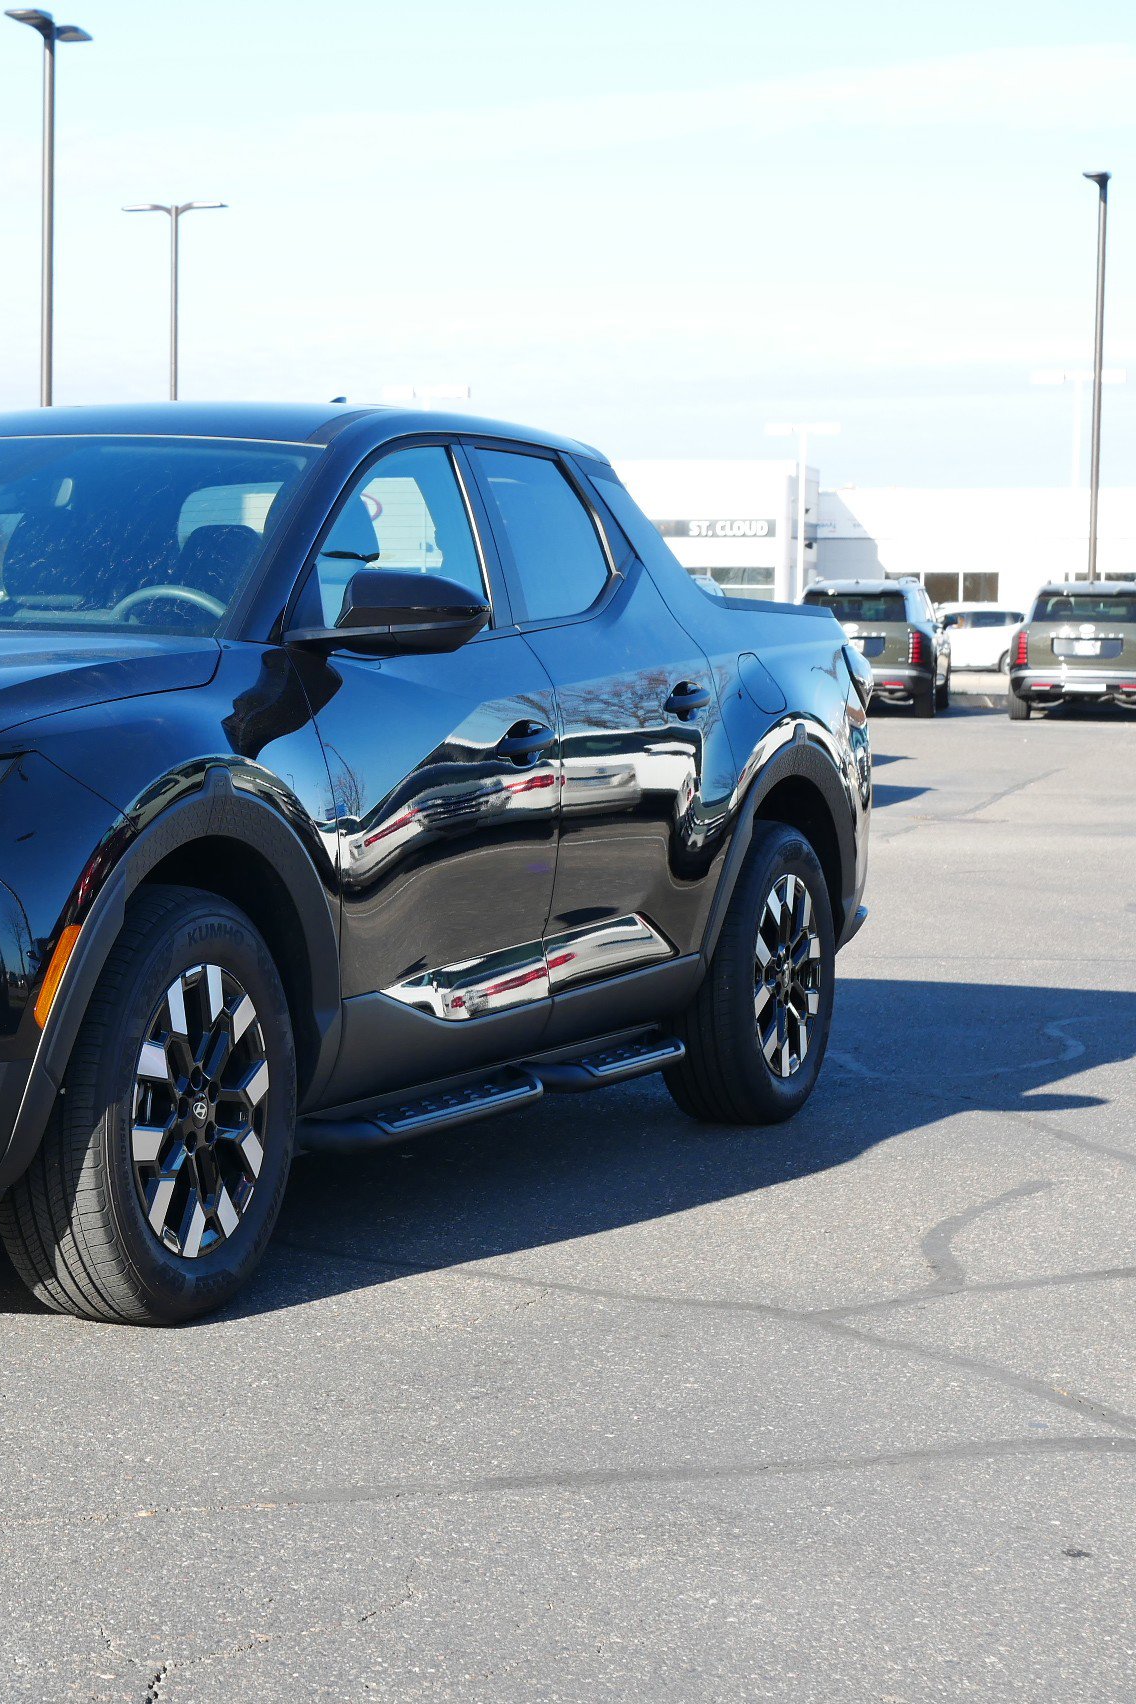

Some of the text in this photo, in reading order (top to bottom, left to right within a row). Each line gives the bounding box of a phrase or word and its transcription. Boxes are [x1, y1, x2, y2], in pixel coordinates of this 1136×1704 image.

[688, 520, 769, 537] ST. CLOUD
[186, 923, 244, 948] KUMHO
